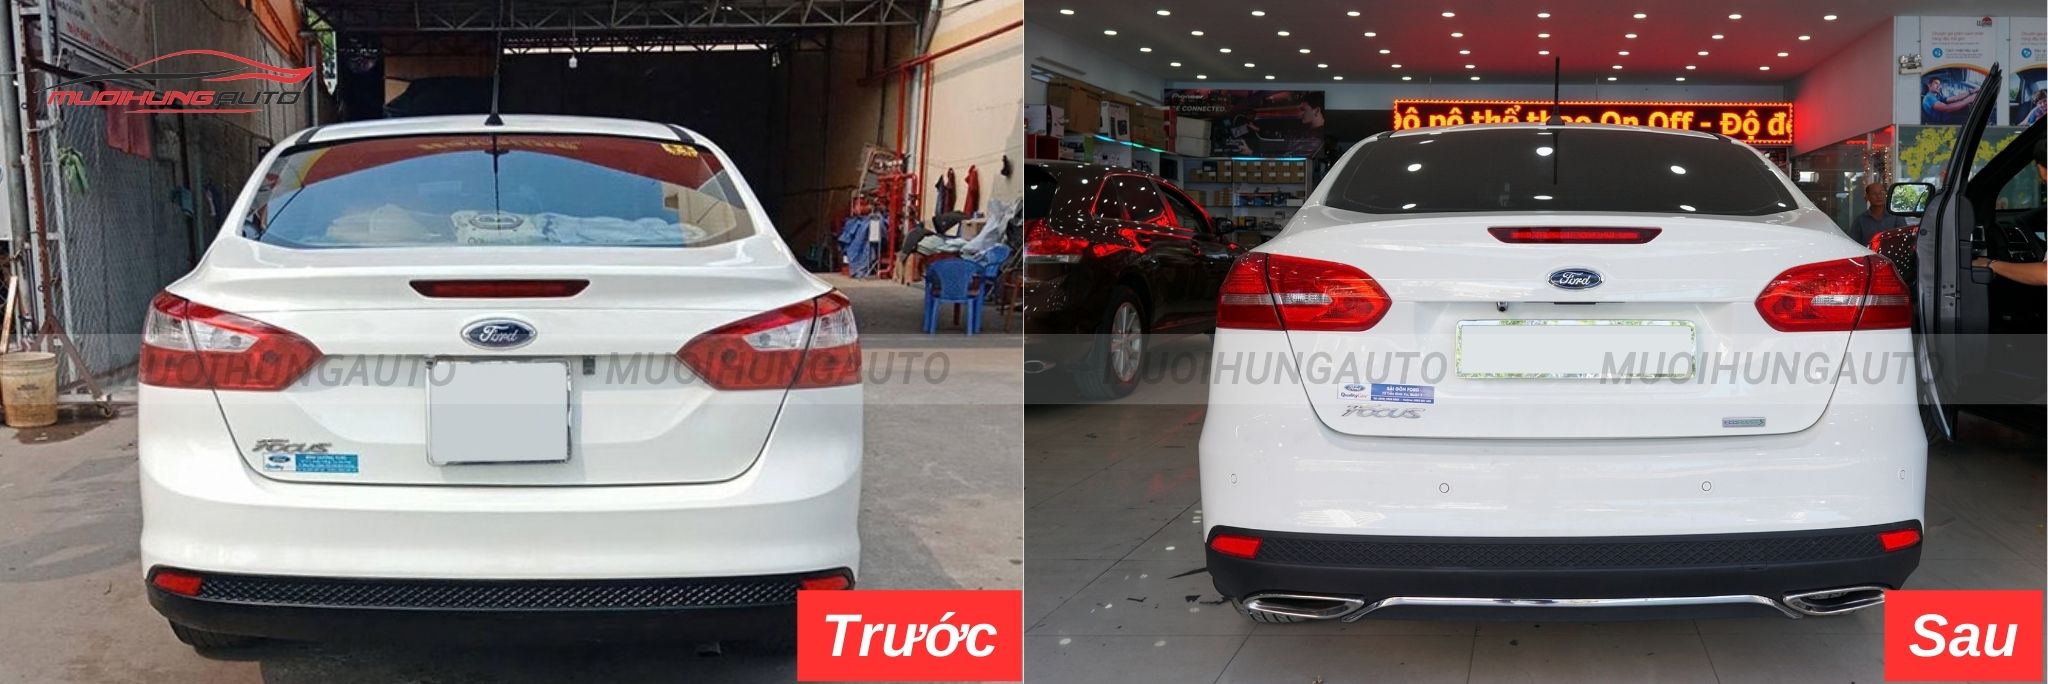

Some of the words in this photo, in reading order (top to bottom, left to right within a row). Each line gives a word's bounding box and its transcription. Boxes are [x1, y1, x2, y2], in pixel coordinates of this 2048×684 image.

[1649, 111, 1694, 130] Off
[1720, 110, 1760, 139] Độ
[1559, 271, 1591, 285] Ford
[479, 325, 519, 343] Ford
